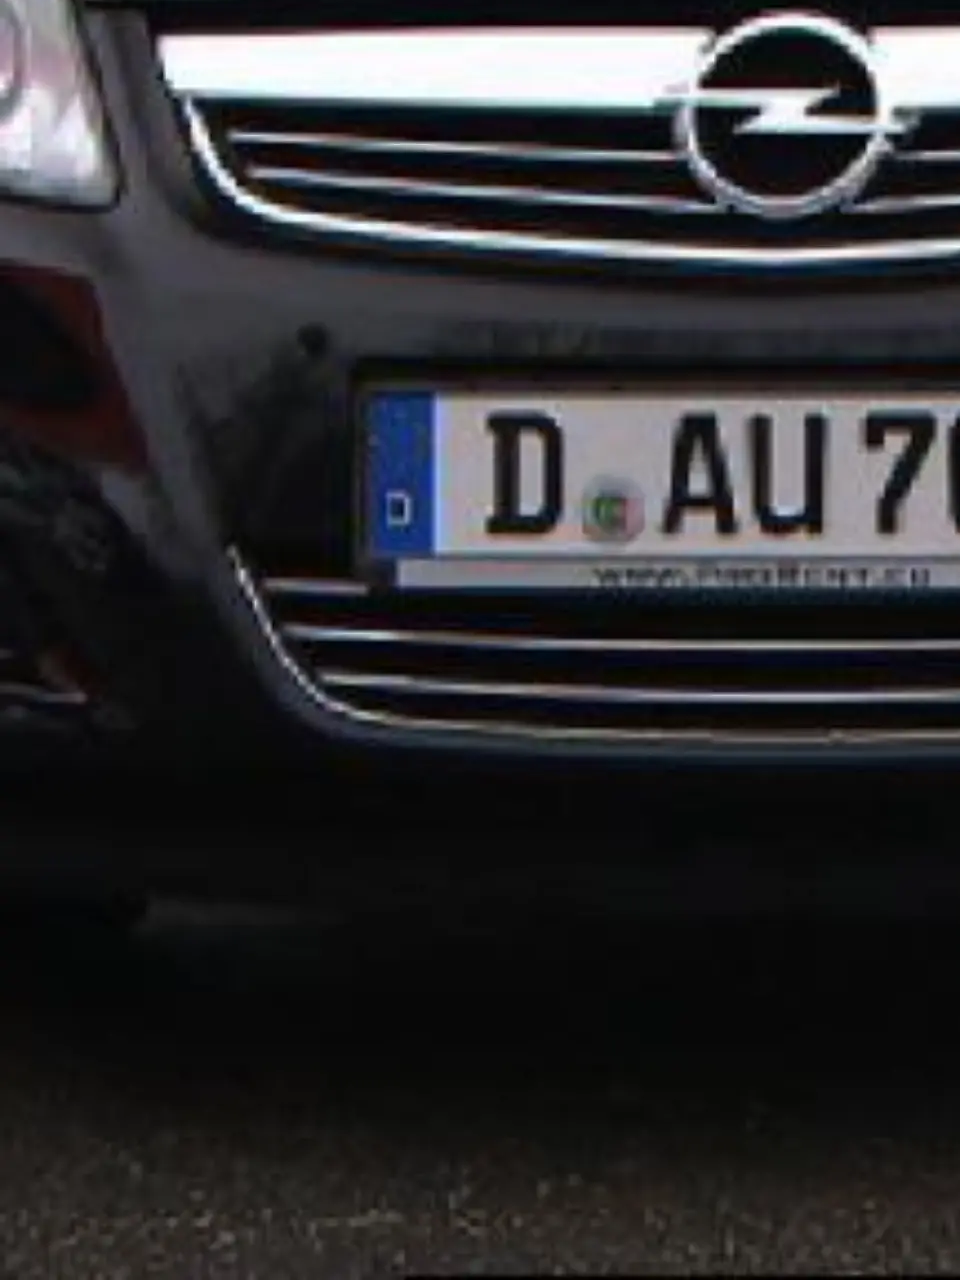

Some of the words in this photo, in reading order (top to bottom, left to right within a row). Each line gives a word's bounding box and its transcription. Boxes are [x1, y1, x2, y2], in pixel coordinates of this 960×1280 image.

[386, 490, 411, 526] D
[485, 408, 563, 534] D
[662, 410, 829, 535] AU
